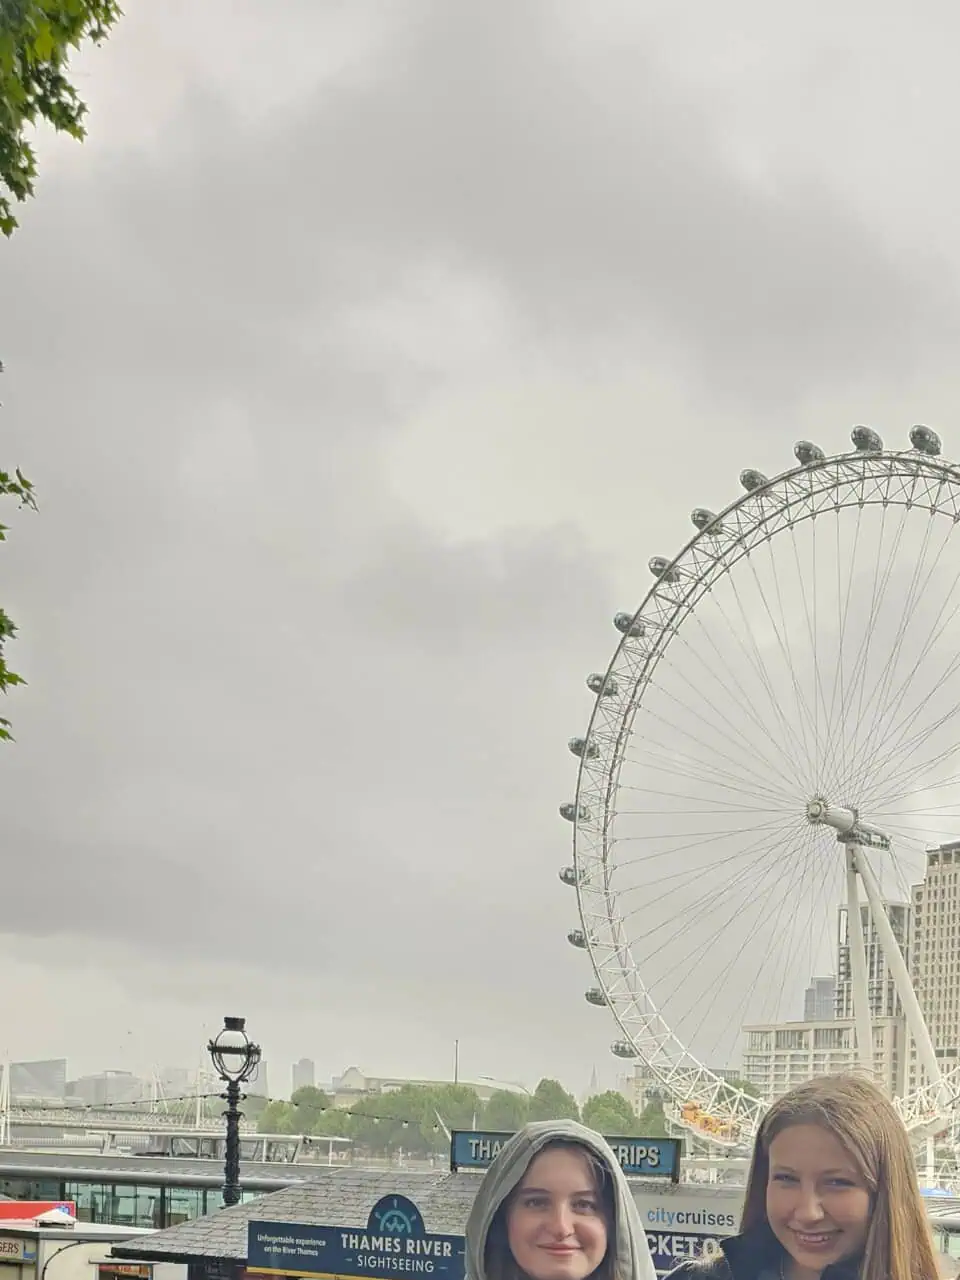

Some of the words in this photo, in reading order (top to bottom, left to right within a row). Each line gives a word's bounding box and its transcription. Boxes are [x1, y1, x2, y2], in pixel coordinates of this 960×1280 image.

[468, 1139, 508, 1159] THA
[647, 1207, 734, 1226] citycruises
[257, 1233, 295, 1245] Unforgettable
[295, 1237, 326, 1247] experience
[341, 1233, 401, 1253] THAMES
[406, 1239, 452, 1257] RIVER
[297, 1248, 319, 1256] Thames
[357, 1255, 434, 1273] SIGHTSEEING
